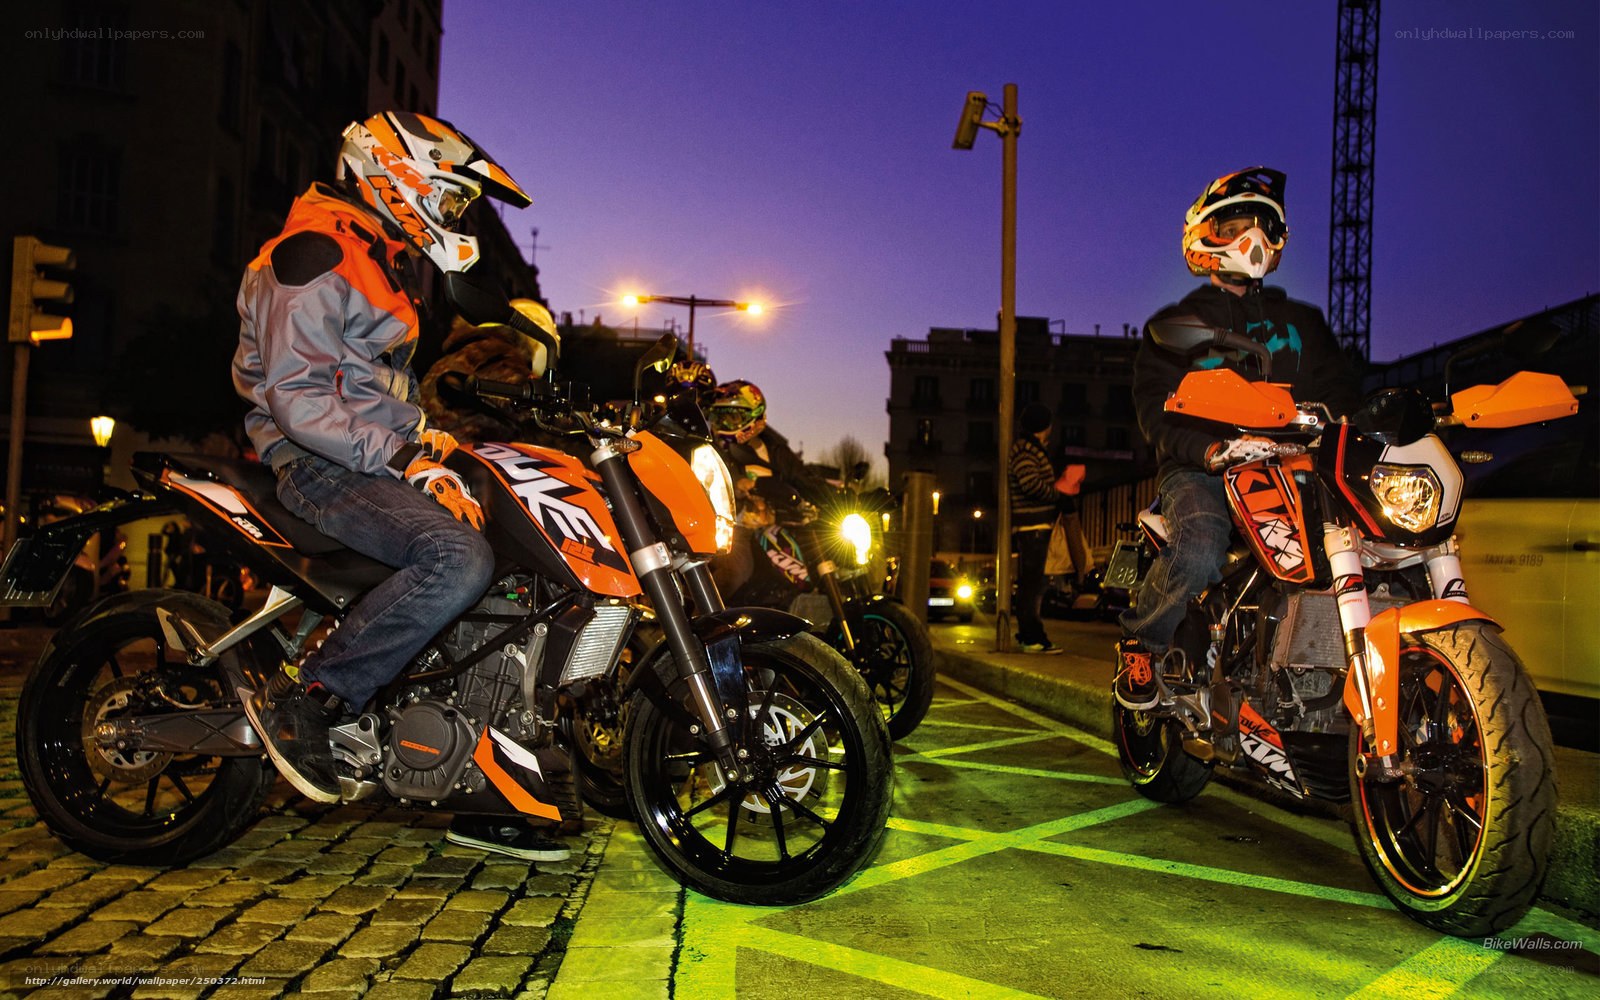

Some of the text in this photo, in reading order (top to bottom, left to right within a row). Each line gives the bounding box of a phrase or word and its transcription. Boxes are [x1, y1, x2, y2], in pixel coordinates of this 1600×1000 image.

[473, 442, 616, 553] DUKE
[231, 516, 264, 539] KTM
[1234, 467, 1305, 571] KTM
[560, 537, 596, 564] 125
[766, 549, 809, 580] KTM
